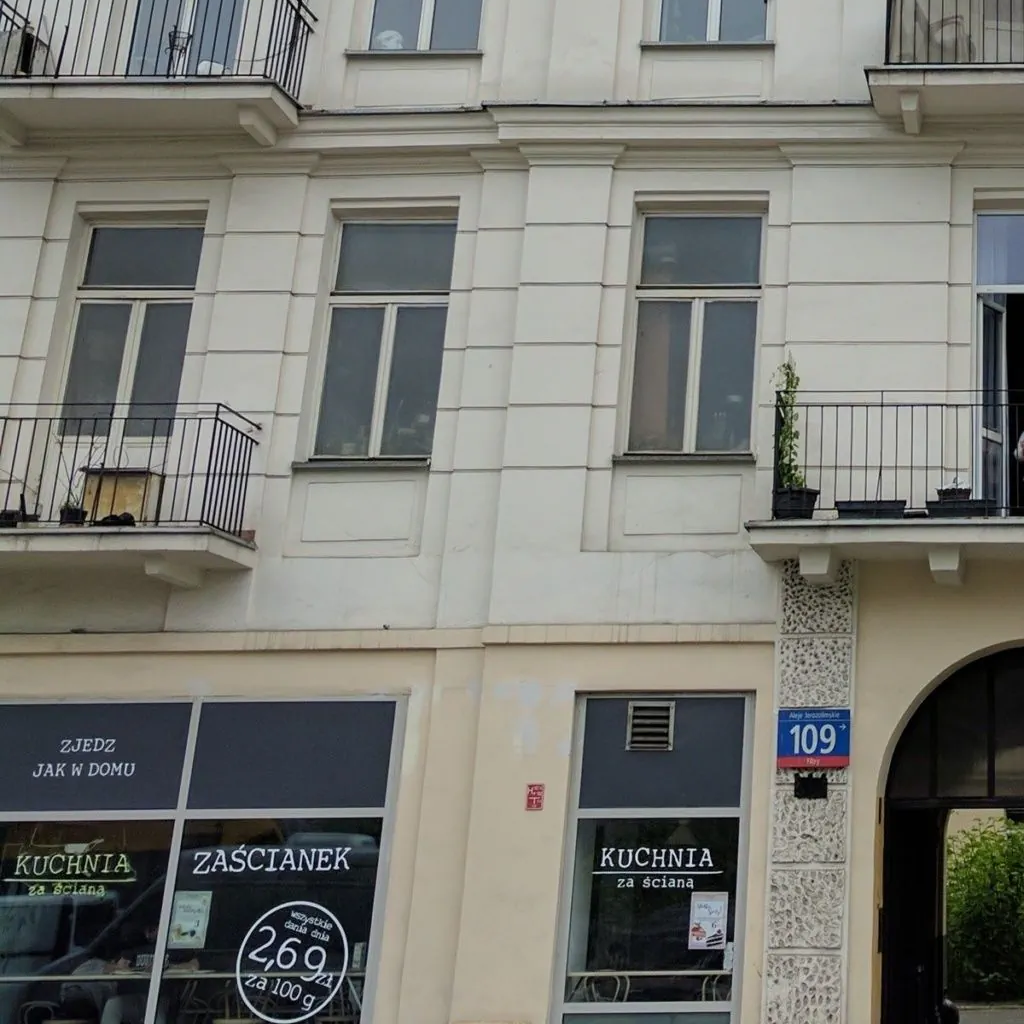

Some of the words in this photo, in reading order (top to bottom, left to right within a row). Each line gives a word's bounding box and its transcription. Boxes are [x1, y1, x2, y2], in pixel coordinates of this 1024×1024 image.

[60, 737, 117, 753] ZJEDZ
[789, 723, 837, 754] 109
[32, 762, 67, 778] JAK
[71, 762, 84, 777] W
[88, 761, 136, 777] DOMU
[14, 853, 131, 876] KUCHNIA
[192, 844, 352, 875] ZAŚCIANEK
[600, 846, 714, 869] KUCHNIA
[28, 883, 46, 896] za
[617, 877, 634, 888] za
[642, 876, 694, 890] ścianą
[284, 920, 308, 934] dania
[310, 929, 330, 942] dnia
[290, 910, 333, 931] wszystkie
[248, 925, 327, 982] 2,69
[244, 973, 268, 991] za
[271, 978, 303, 1001] 100
[301, 994, 316, 1012] g
